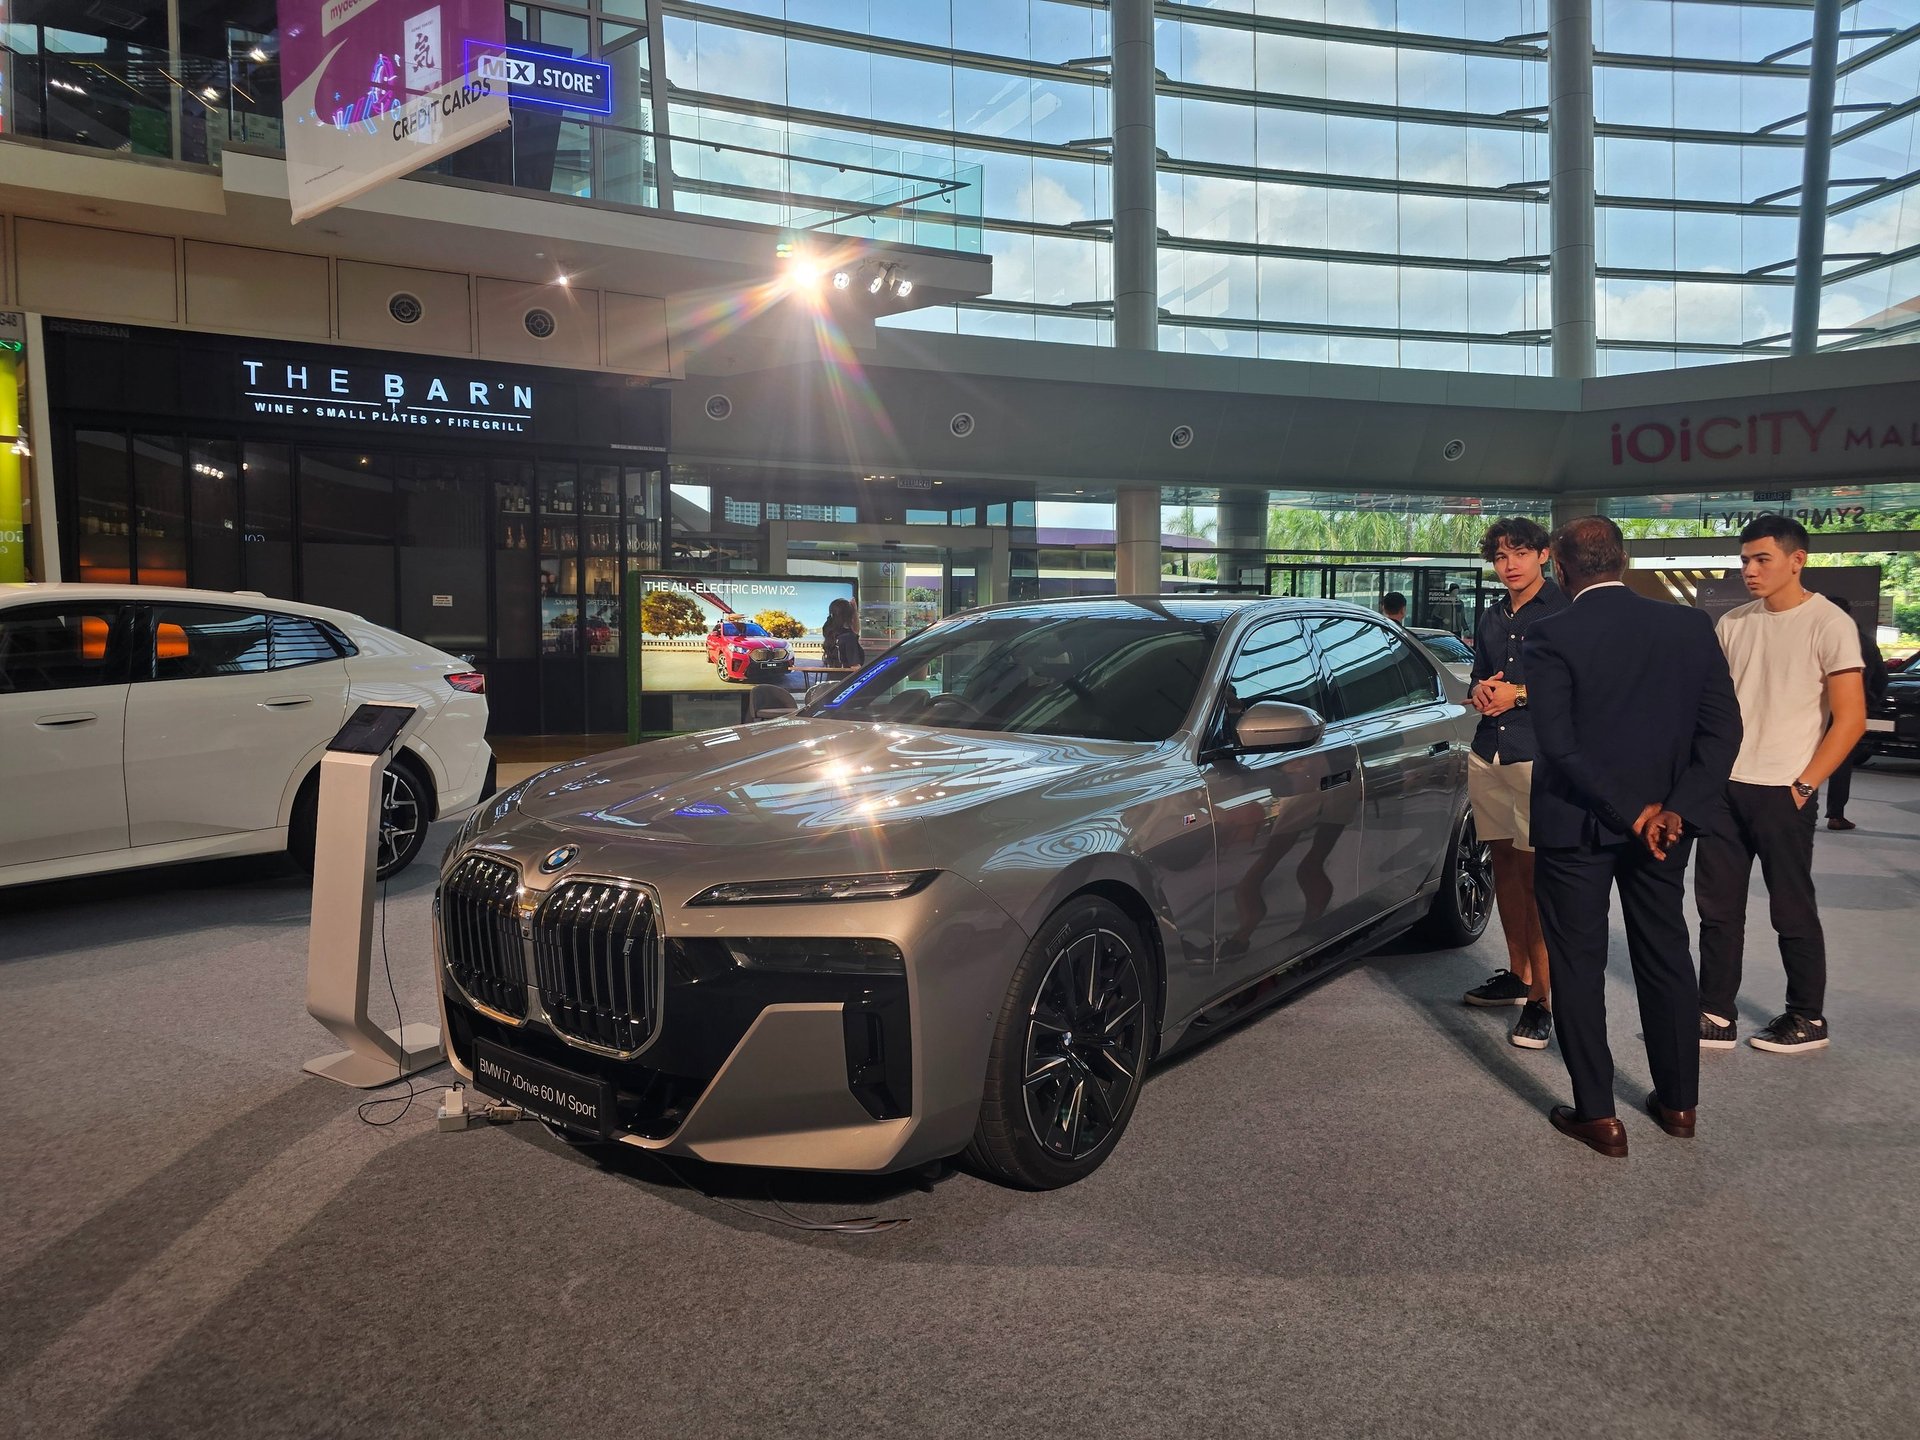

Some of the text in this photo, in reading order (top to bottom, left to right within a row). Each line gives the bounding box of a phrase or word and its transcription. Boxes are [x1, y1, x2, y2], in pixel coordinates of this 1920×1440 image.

[392, 78, 491, 142] CREDIT CARDS
[243, 361, 350, 394] THE
[255, 402, 523, 432] WINE SMALL PLATES FIREGRILL
[644, 581, 669, 592] THE
[671, 582, 749, 595] ALL-ELECTRIC
[751, 584, 778, 596] BMW
[480, 1058, 597, 1119] BMW i7 xDrive 60 M Sport
